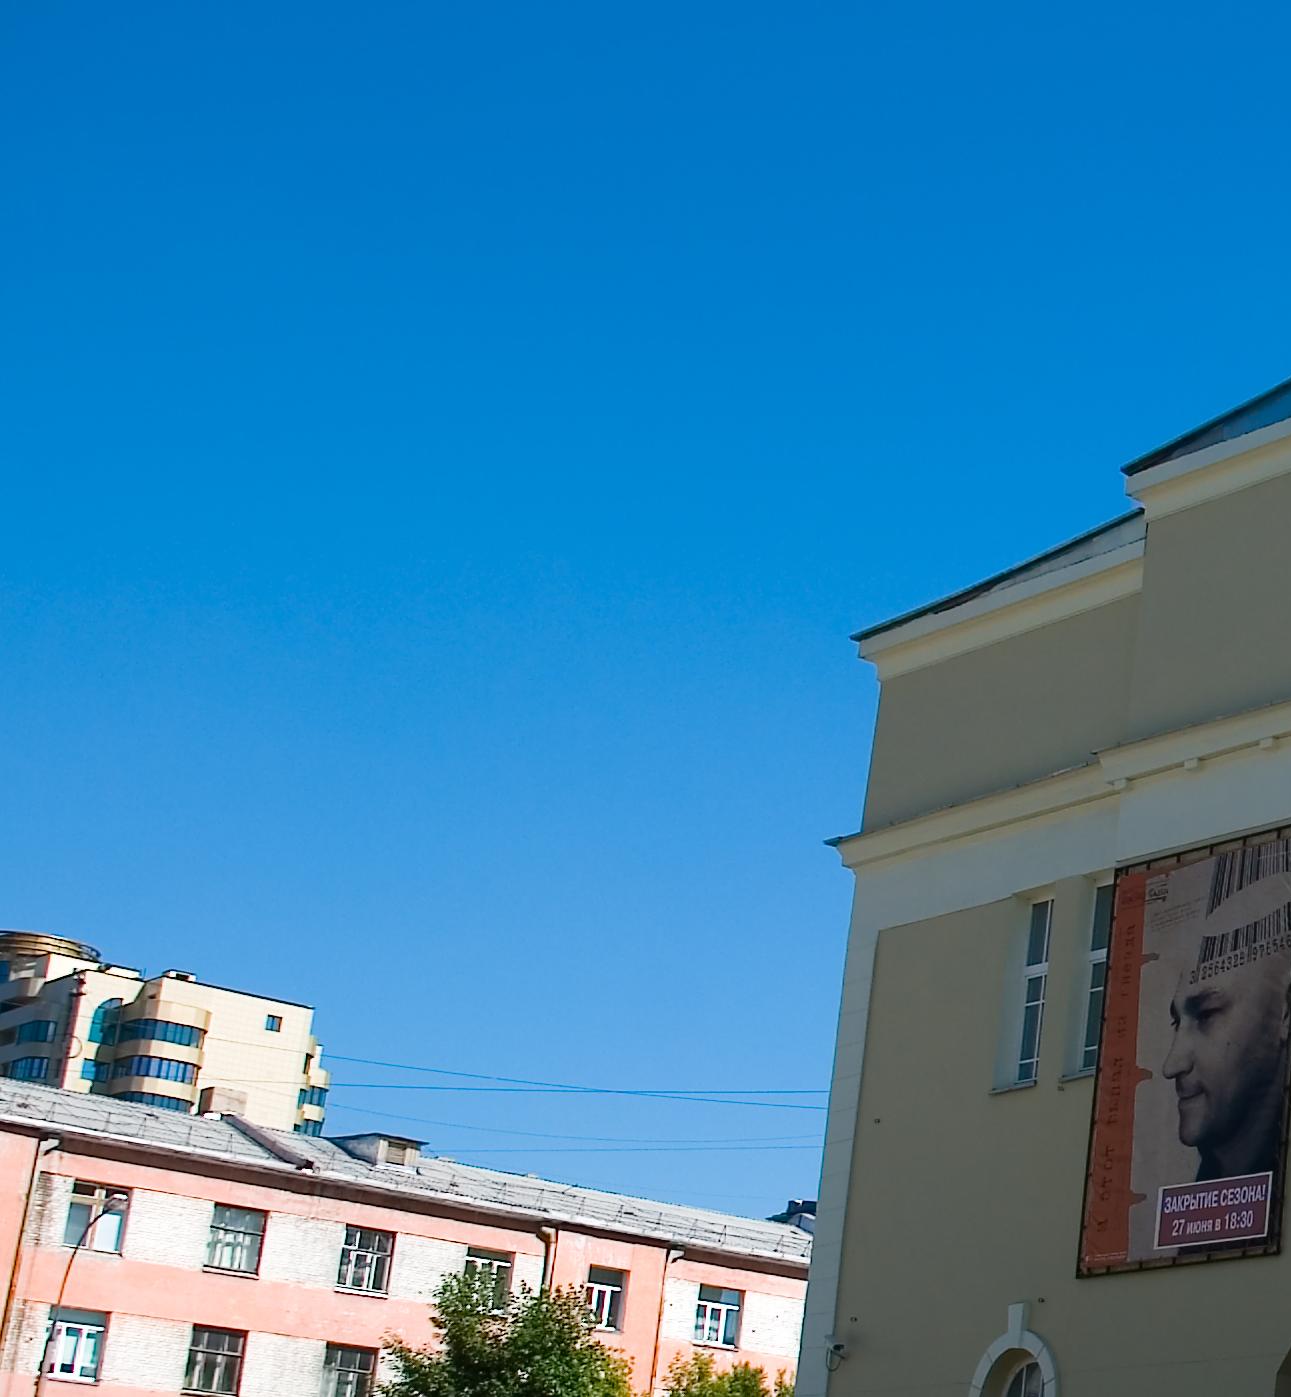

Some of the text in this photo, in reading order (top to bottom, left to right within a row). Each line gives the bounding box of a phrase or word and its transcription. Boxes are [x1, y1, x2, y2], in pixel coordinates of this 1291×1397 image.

[1164, 1184, 1266, 1213] ЗАКРЫТИЕ СЕЗОНА!
[1172, 1218, 1185, 1236] 27
[1186, 1219, 1213, 1235] июня
[1225, 1210, 1254, 1230] 18:30
